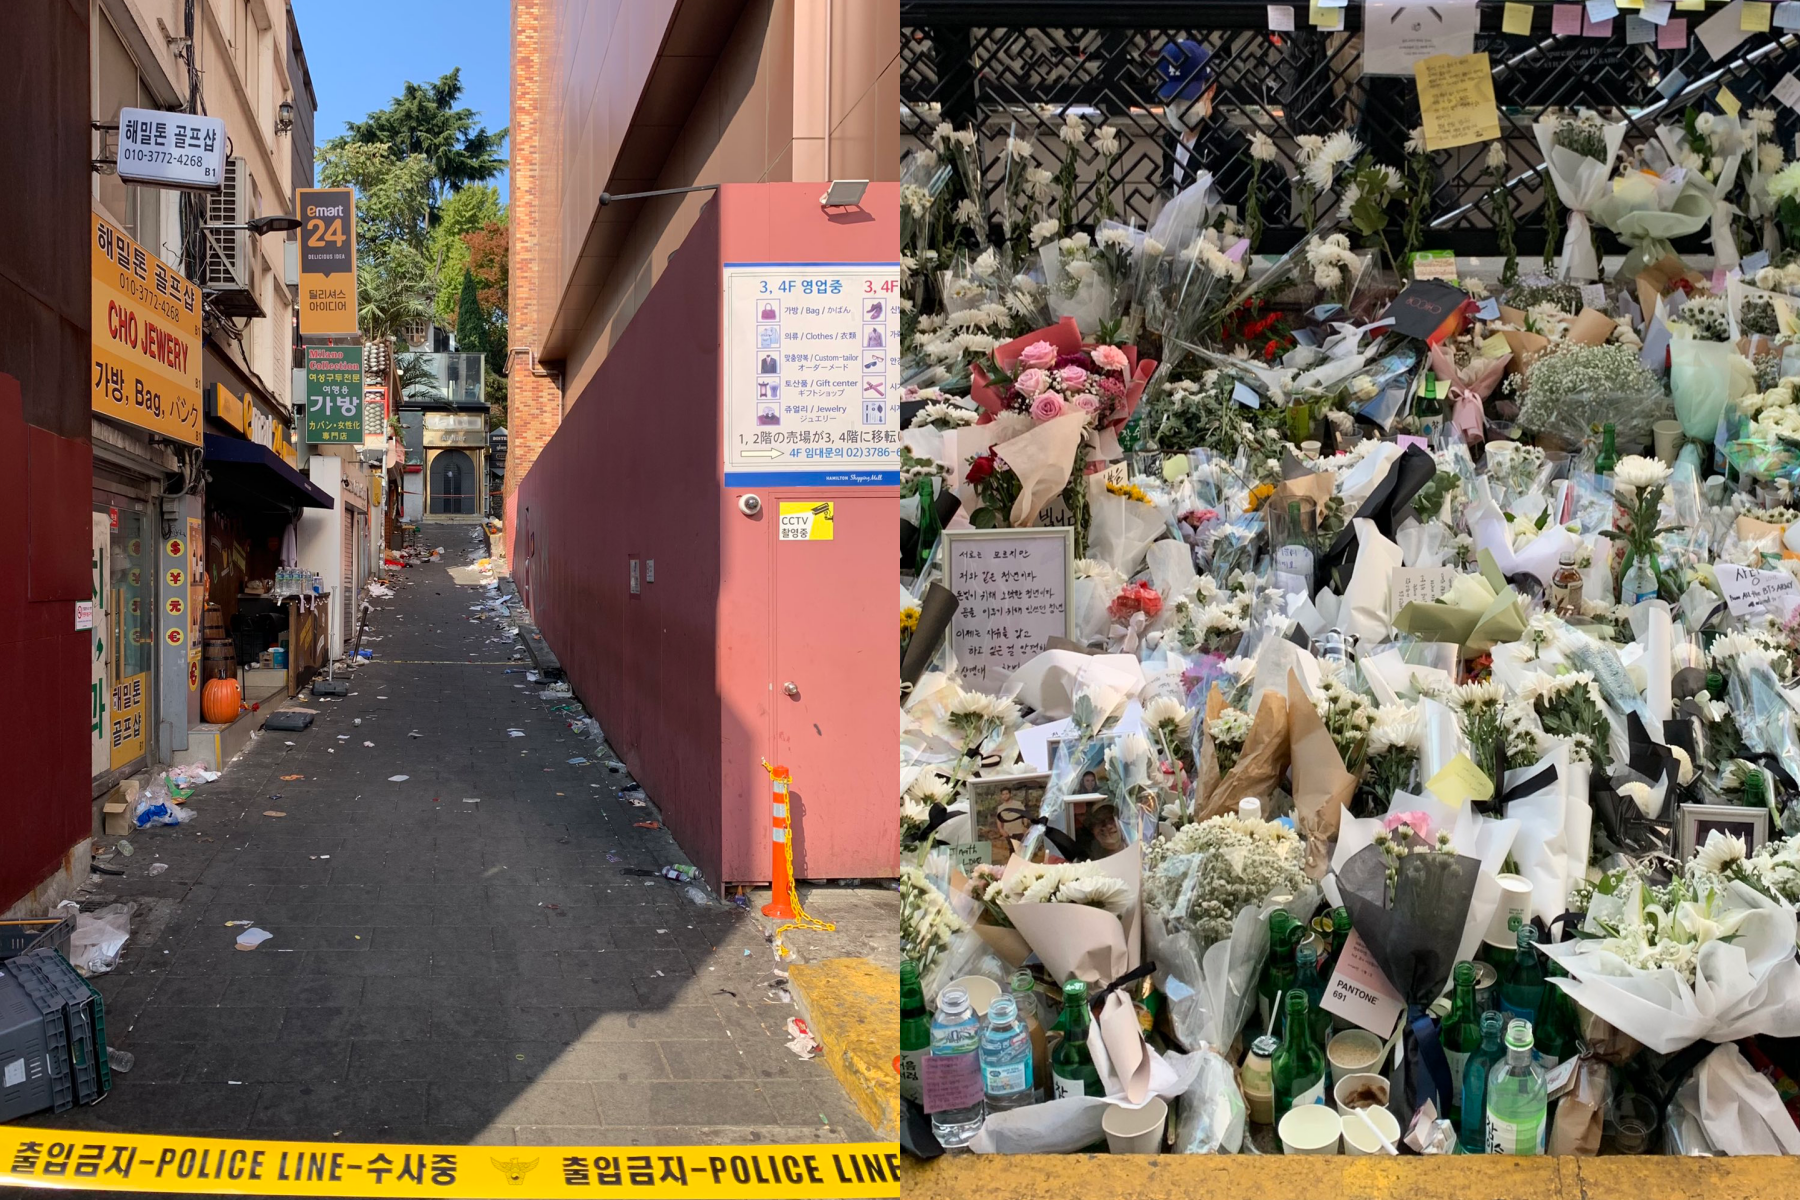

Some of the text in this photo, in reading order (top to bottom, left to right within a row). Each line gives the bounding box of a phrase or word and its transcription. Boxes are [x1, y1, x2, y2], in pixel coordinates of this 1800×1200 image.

[125, 120, 217, 153] 해밀톤 골프샵
[124, 148, 203, 168] 010-3772-4268
[204, 167, 216, 177] B1
[306, 205, 343, 217] emart
[307, 218, 346, 247] 24
[97, 222, 195, 314] 해밀톤 골프샵
[759, 280, 843, 295] 3, 4F 영업중
[864, 280, 877, 295] 3,
[119, 272, 180, 323] 010-3772-4268
[308, 289, 347, 300] 딜리셔스
[309, 301, 347, 311] 아이디어
[784, 306, 799, 315] 가방
[806, 306, 820, 316] Bag
[827, 306, 851, 314] かばん
[107, 299, 188, 375] CHO JEWERY
[784, 332, 799, 341] 의류
[805, 332, 834, 340] Clothes
[840, 331, 857, 340] 衣類
[308, 349, 344, 359] Milano
[814, 354, 859, 362] Custom-tailor
[308, 361, 360, 371] Collection
[798, 364, 849, 372] オーダーメード
[784, 380, 808, 388] 토산품
[815, 379, 831, 387] Gift
[95, 361, 129, 406] 가방,
[135, 378, 165, 420] Bag,
[322, 385, 349, 395] 여행용
[798, 389, 845, 397] ギフトショップ
[310, 395, 360, 417] 가방
[784, 405, 808, 414] 쥬얼리
[815, 405, 847, 415] Jewelry
[800, 415, 837, 423] ジュエリー
[789, 448, 802, 458] 4F
[805, 447, 844, 459] 임대문의
[781, 516, 809, 525] CCTV
[781, 528, 808, 538] 촬영중
[112, 680, 141, 711] 해밀톤
[112, 711, 141, 747] 골프샵
[1332, 990, 1347, 1002] 691
[1336, 979, 1378, 1006] PANTONE
[10, 1141, 457, 1184] 출입금지-POLICE LINE-수사중
[562, 1154, 823, 1187] 출입금지-POLICE
